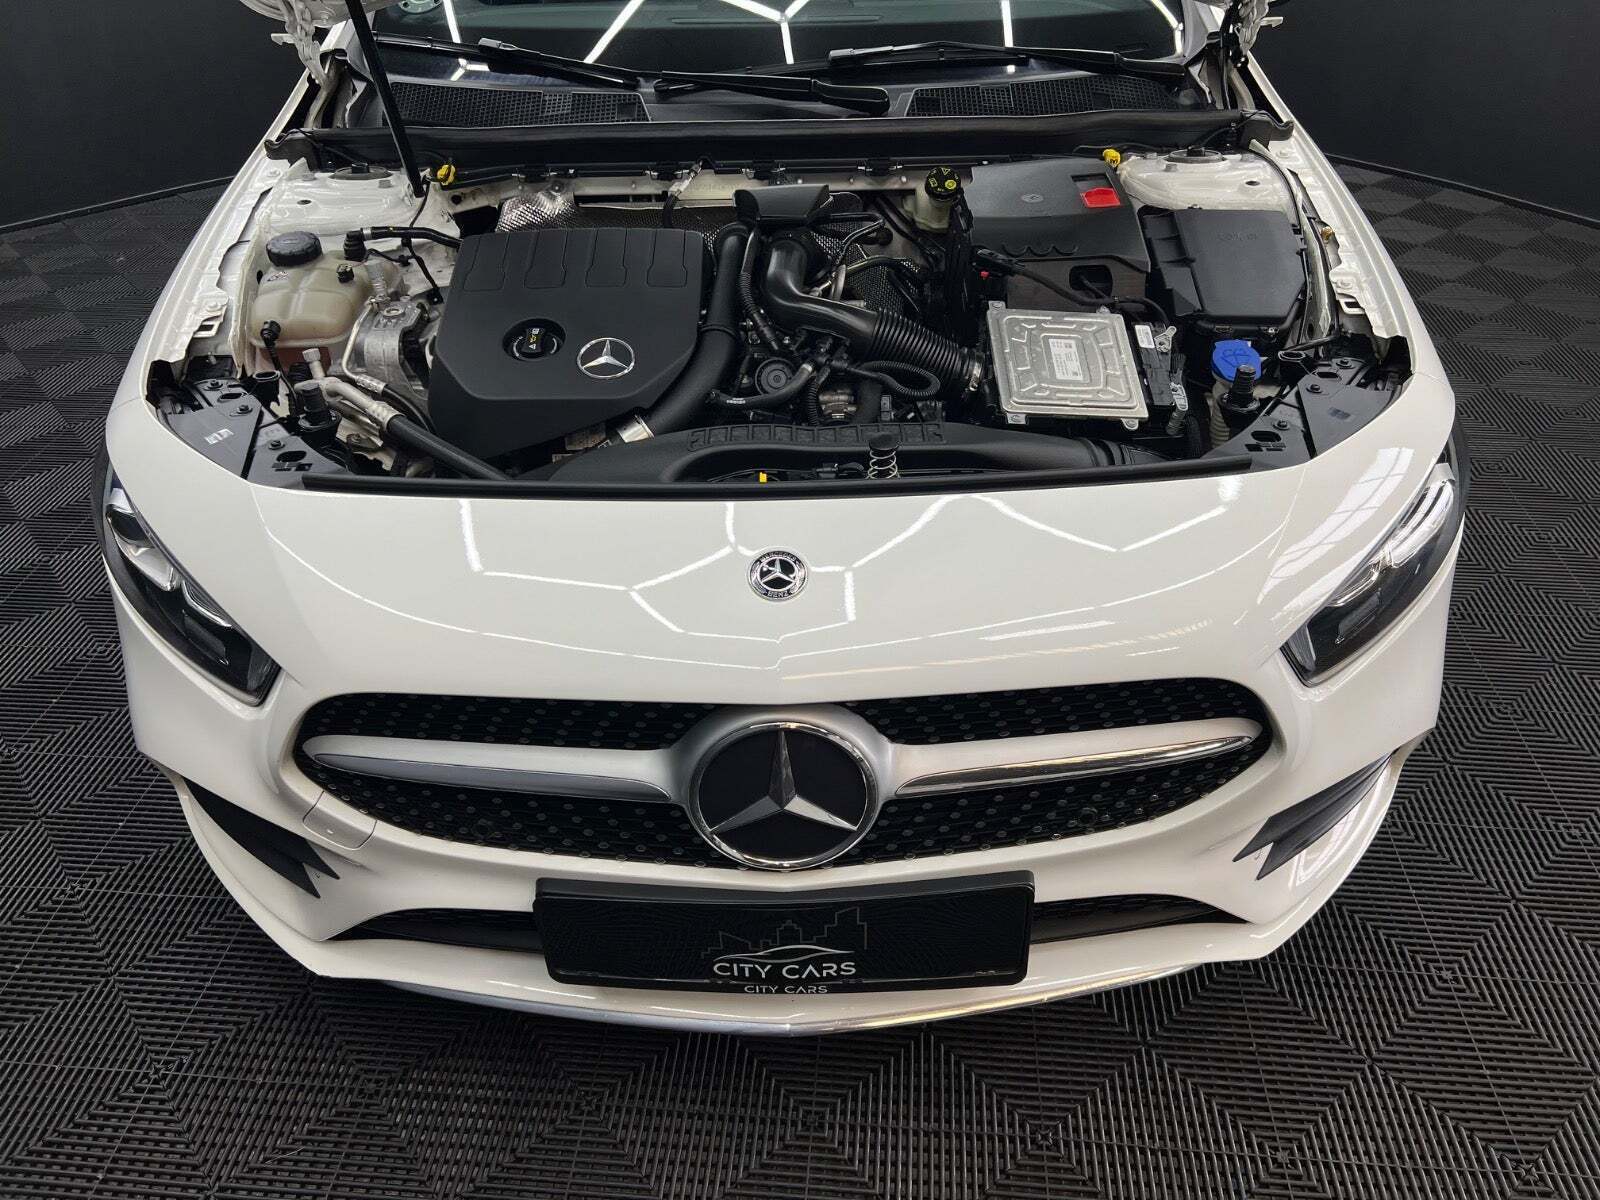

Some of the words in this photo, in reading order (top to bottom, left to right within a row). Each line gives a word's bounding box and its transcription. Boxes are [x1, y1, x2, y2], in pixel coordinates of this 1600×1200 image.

[713, 963, 772, 979] CITY
[782, 962, 856, 979] CARS
[744, 985, 779, 994] CITY
[784, 985, 828, 994] CARS
